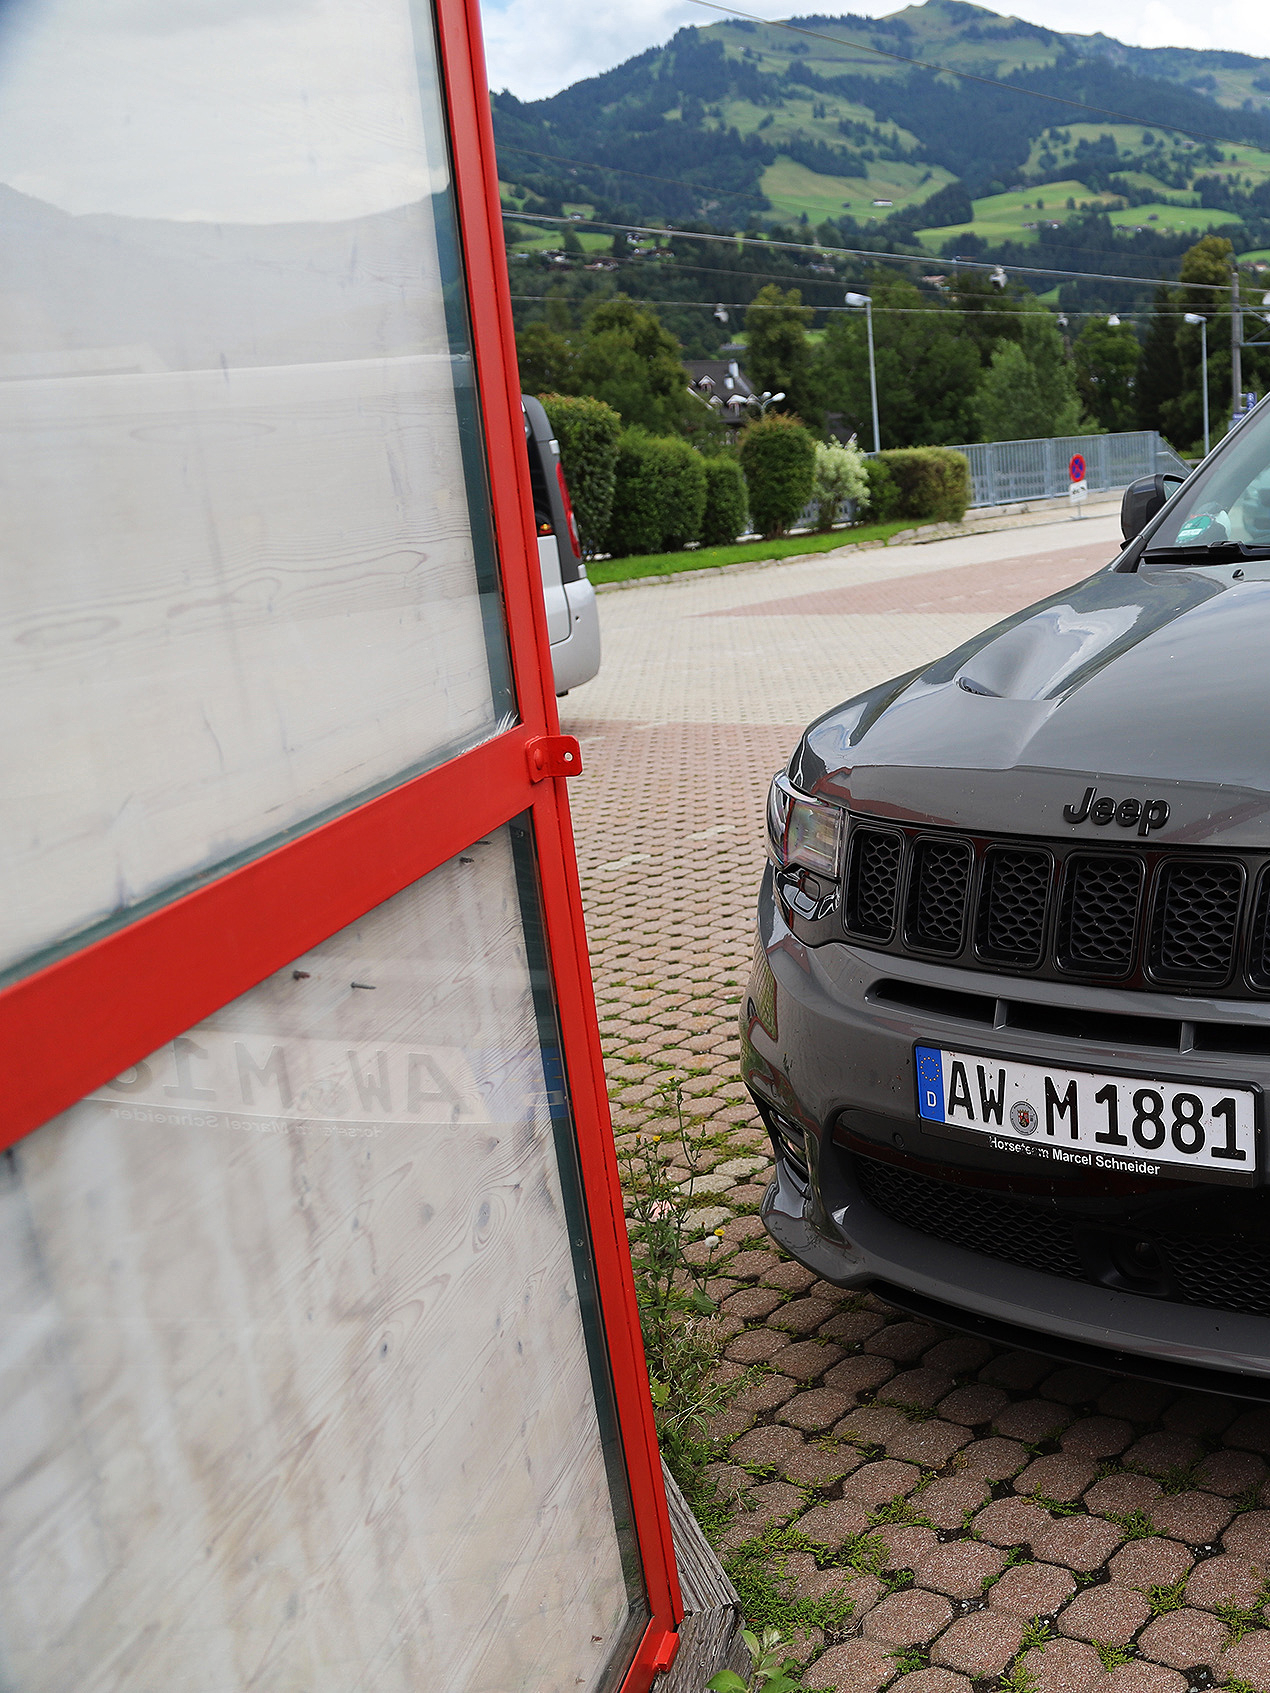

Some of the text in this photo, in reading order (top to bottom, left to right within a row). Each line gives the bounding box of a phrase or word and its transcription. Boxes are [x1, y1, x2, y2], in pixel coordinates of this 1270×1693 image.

[1063, 786, 1171, 837] Jeep
[926, 1090, 937, 1107] D
[947, 1060, 1006, 1126] AW
[1094, 1083, 1247, 1161] 1881
[1052, 1148, 1093, 1167] Marcel
[1095, 1155, 1161, 1176] Schneider
